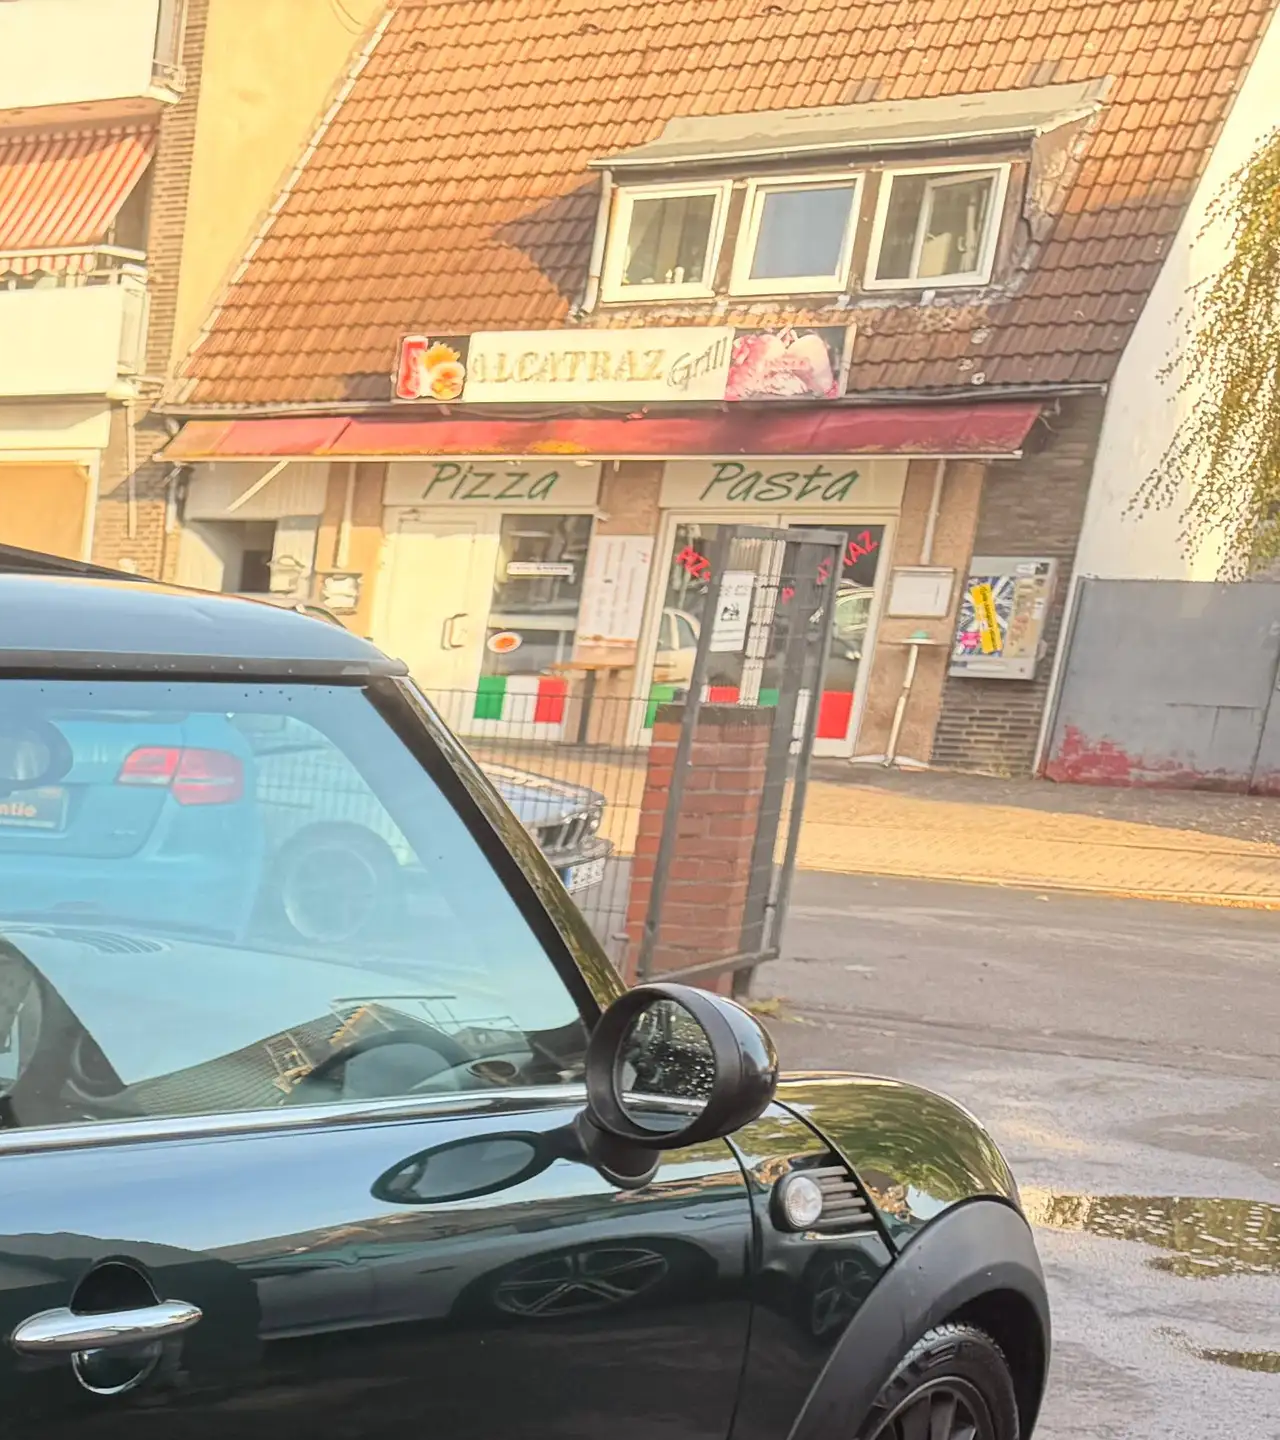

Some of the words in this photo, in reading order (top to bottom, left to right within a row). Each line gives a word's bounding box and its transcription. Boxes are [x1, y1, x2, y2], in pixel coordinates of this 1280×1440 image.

[471, 349, 666, 384] ALCATRAZ
[667, 336, 729, 391] Grill
[421, 461, 561, 500] Pizza
[699, 460, 861, 502] Pasta
